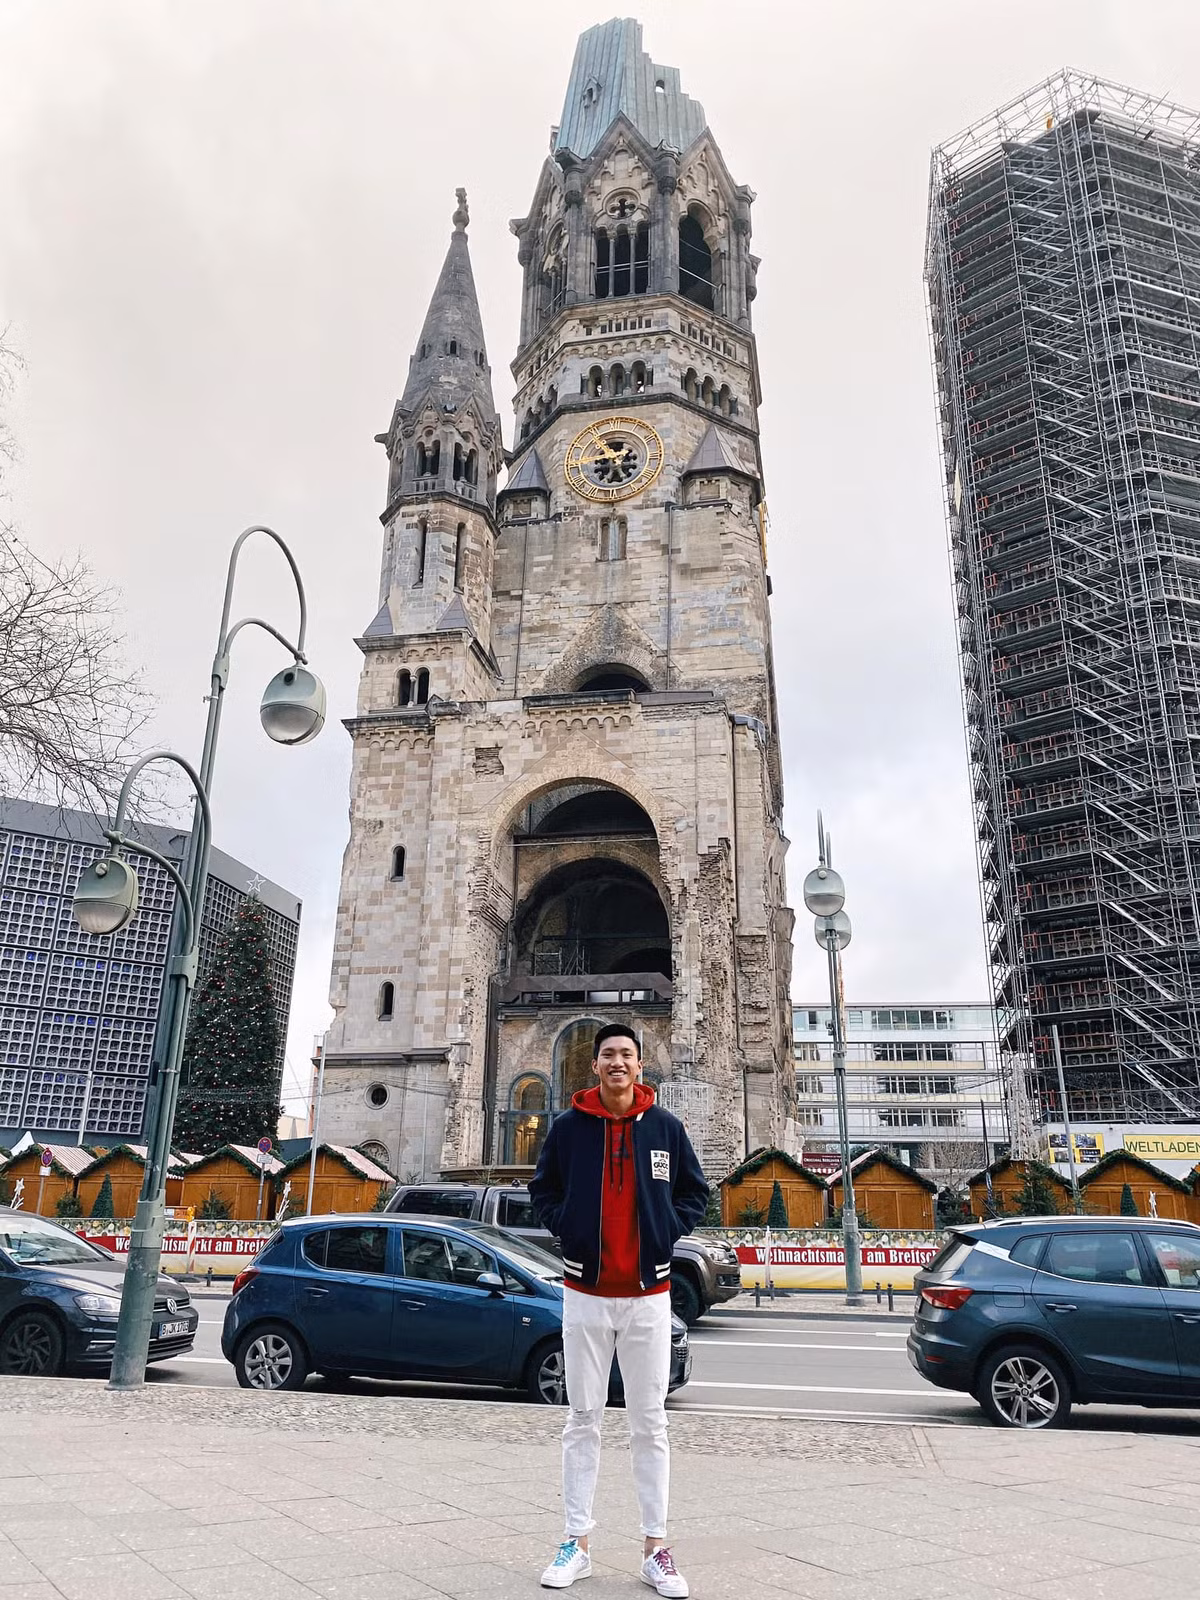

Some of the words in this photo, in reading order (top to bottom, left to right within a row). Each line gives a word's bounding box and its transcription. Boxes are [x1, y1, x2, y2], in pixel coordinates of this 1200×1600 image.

[215, 1240, 233, 1252] am
[755, 1248, 862, 1263] Weihnachtsma
[867, 1251, 886, 1263] am
